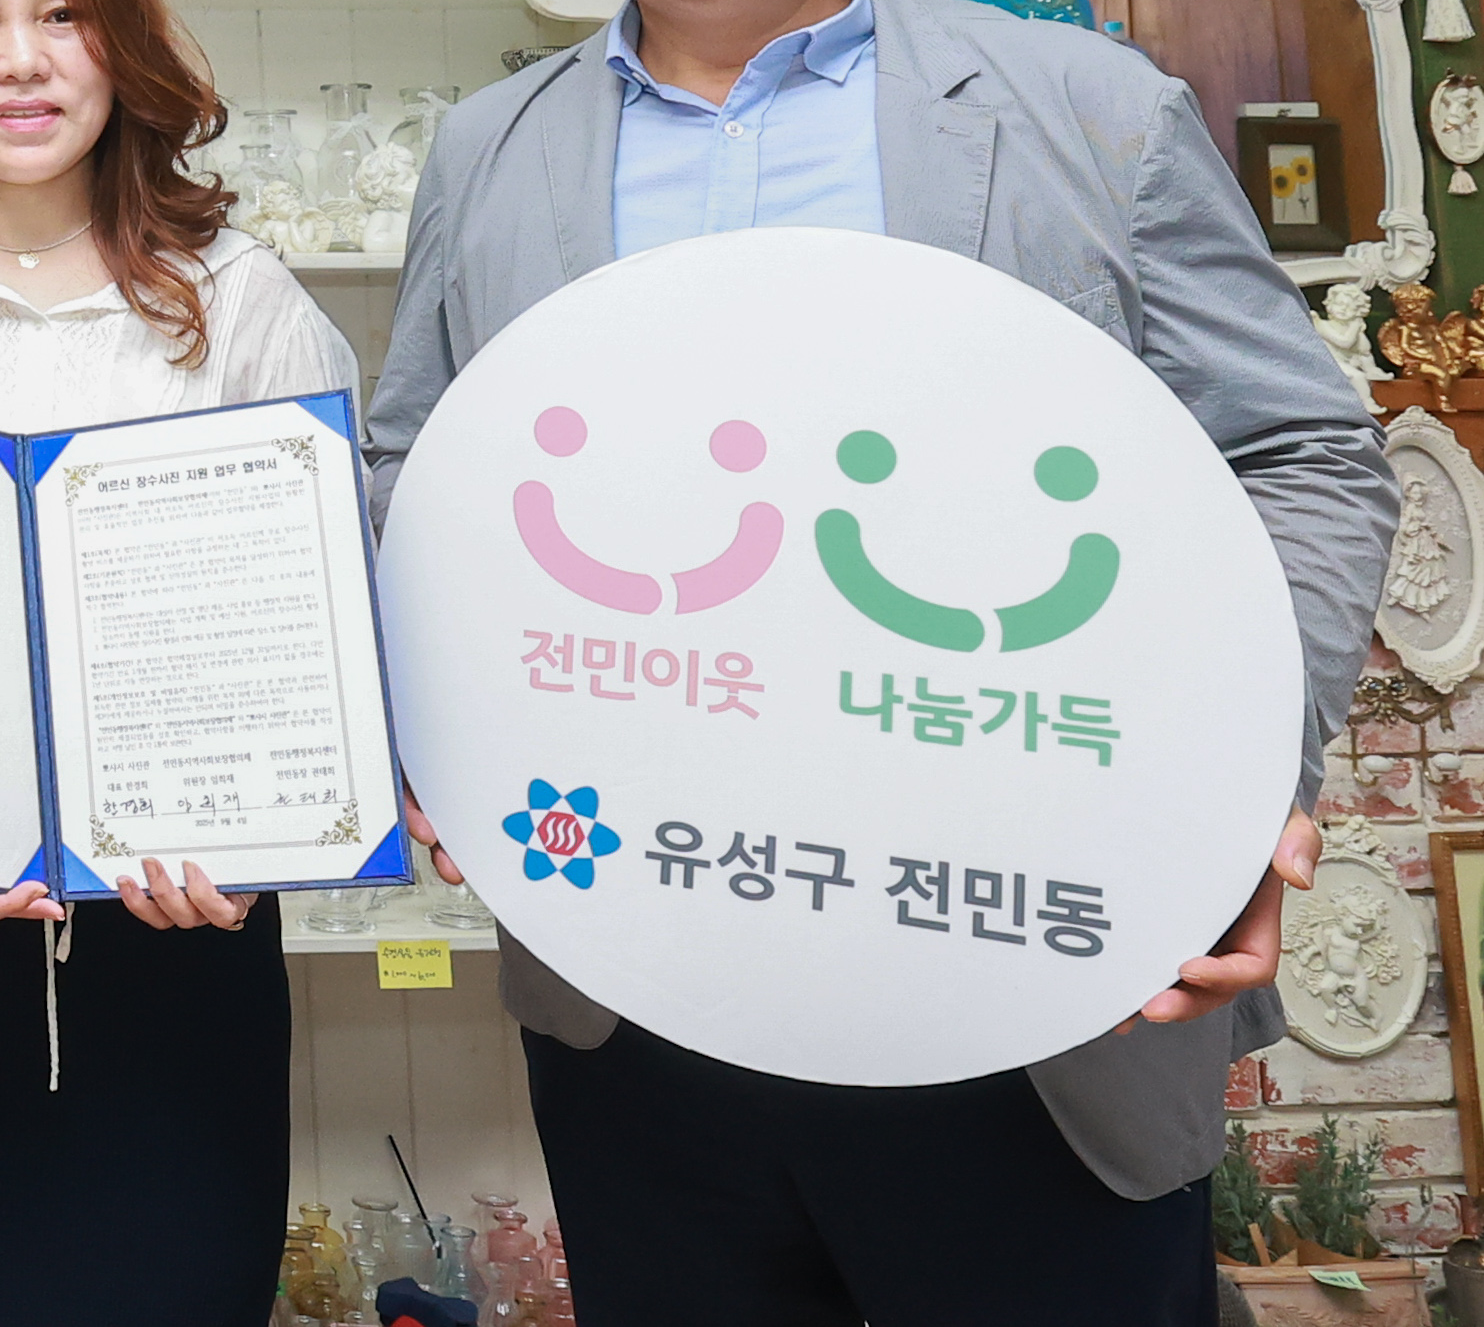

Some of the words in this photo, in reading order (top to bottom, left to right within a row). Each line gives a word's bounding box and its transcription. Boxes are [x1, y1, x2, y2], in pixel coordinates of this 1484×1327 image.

[97, 477, 131, 494] 어르신
[136, 472, 181, 490] 장수사진
[186, 468, 209, 482] 지원
[214, 464, 237, 479] 업무
[243, 458, 278, 474] 협약서
[519, 628, 767, 720] 전민이웃
[837, 670, 1123, 767] 나눔가득
[644, 820, 857, 912] 유성구
[884, 855, 1114, 958] 전민동
